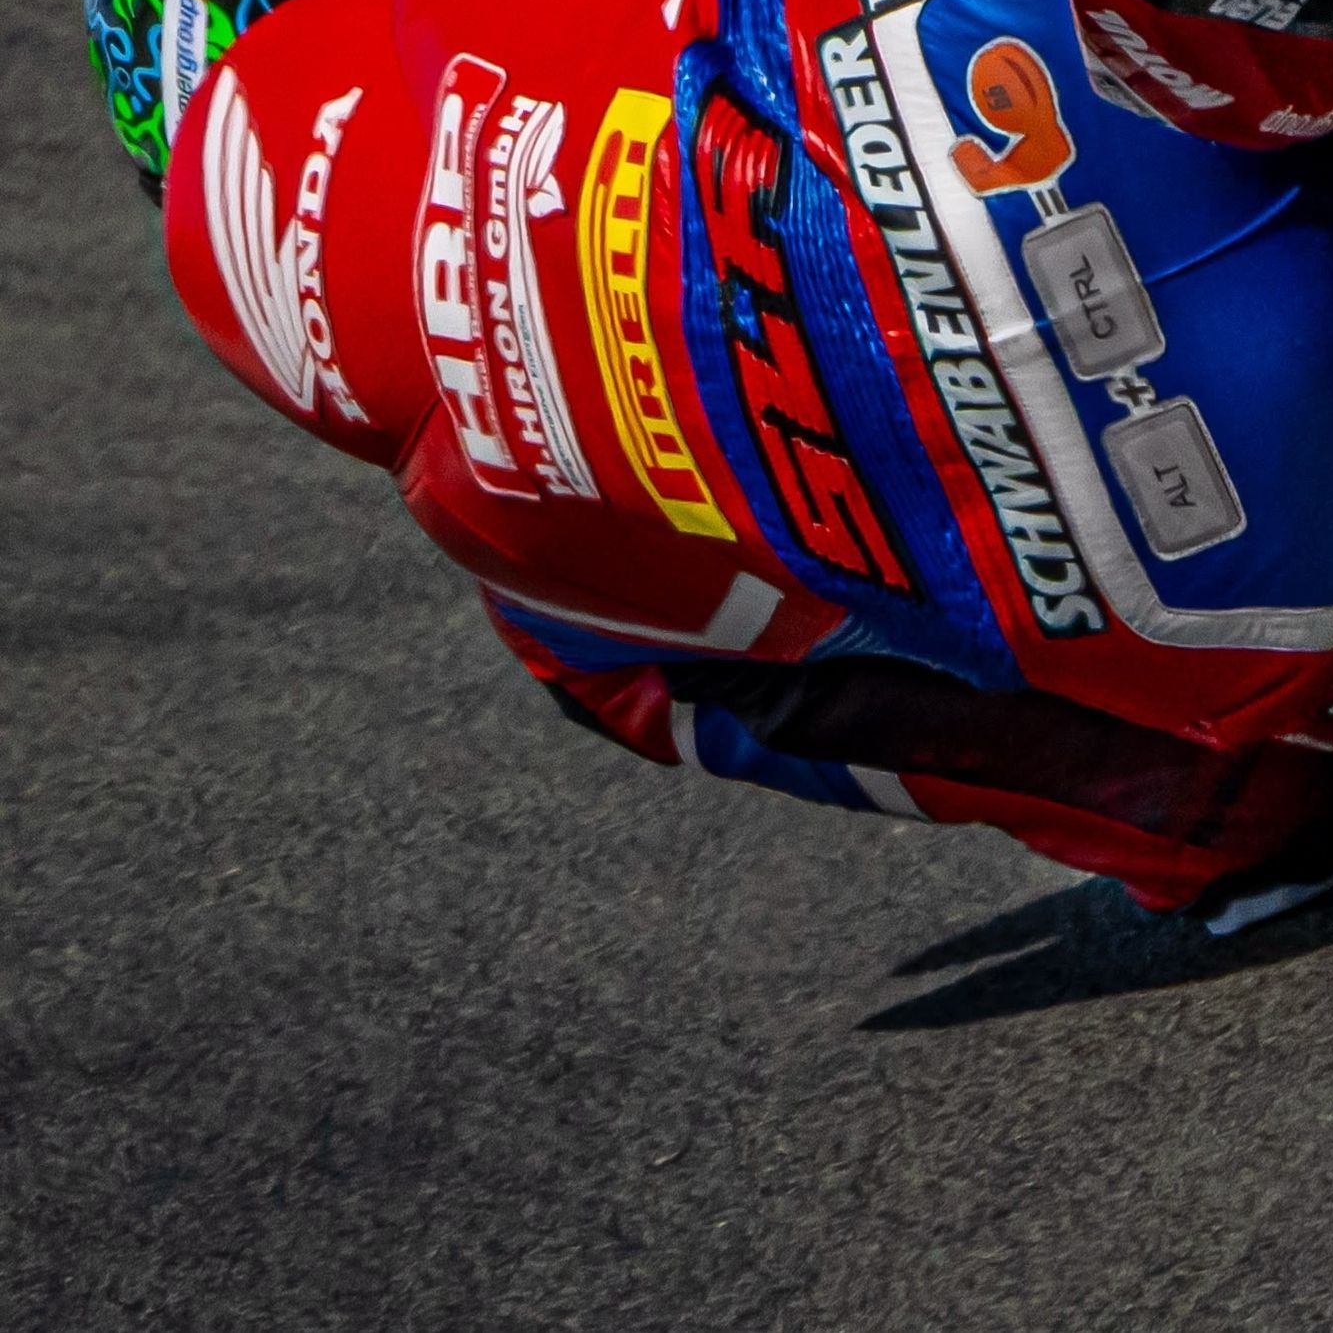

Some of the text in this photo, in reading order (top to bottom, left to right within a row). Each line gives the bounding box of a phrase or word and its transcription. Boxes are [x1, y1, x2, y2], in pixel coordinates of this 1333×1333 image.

[296, 85, 371, 425] HONDA
[422, 92, 518, 471] HRP
[485, 94, 538, 260] GmbH
[1069, 253, 1119, 339] CTRL
[487, 279, 577, 496] H.HRON
[598, 129, 710, 505] PIRELLI
[820, 27, 1100, 634] SCHWABENLEDER
[1153, 464, 1197, 509] ALT
